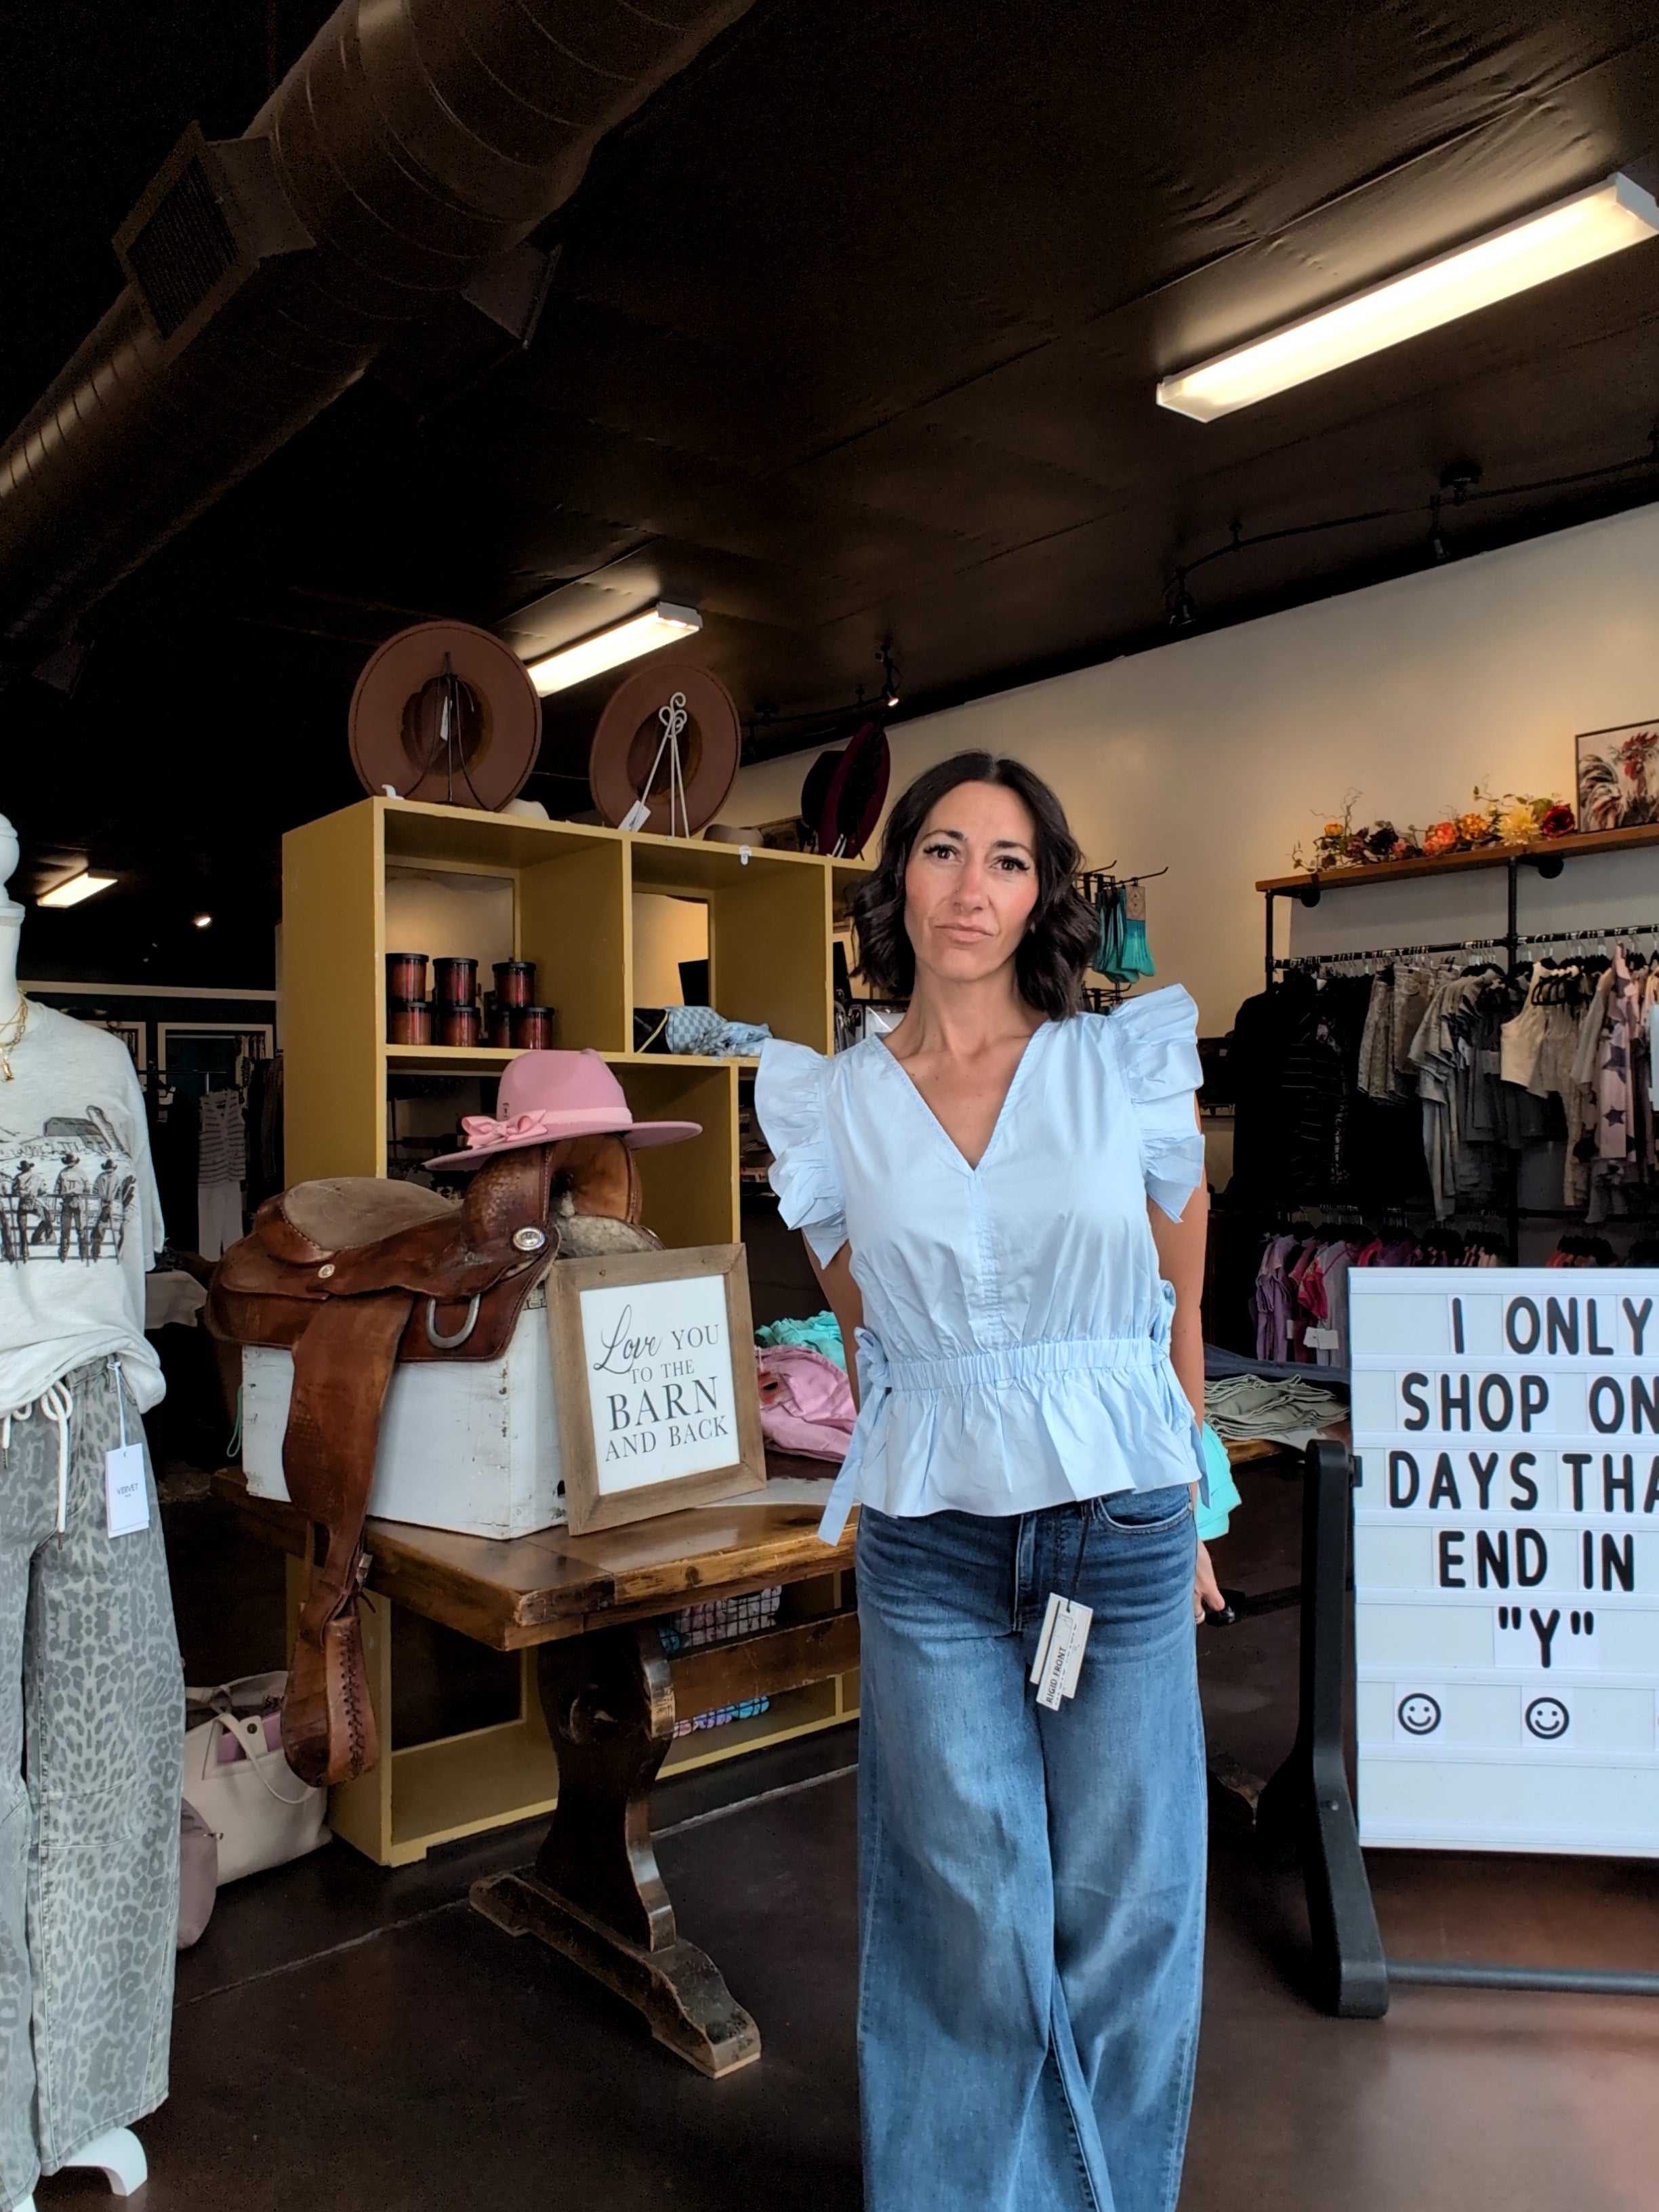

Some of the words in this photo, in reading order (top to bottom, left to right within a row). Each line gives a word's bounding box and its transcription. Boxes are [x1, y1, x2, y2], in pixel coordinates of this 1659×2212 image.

[594, 1305, 663, 1374] Love
[671, 1324, 720, 1350] YOU
[1452, 1297, 1465, 1354] I
[1506, 1296, 1653, 1355] ONLY
[630, 1366, 653, 1385] TO
[660, 1359, 695, 1378] THE
[607, 1376, 718, 1431] BARN
[1401, 1372, 1549, 1433] SHOP
[1589, 1376, 1659, 1435] ON
[605, 1431, 657, 1462] AND
[669, 1416, 729, 1448] BACK
[116, 1483, 138, 1495] VERVET
[1389, 1450, 1538, 1511] DAYS
[1439, 1528, 1548, 1589] END
[1583, 1530, 1635, 1592] IN
[1498, 1606, 1594, 1668] "Y"
[1046, 1679, 1059, 1704] RIGID
[1053, 1647, 1067, 1679] FRONT
